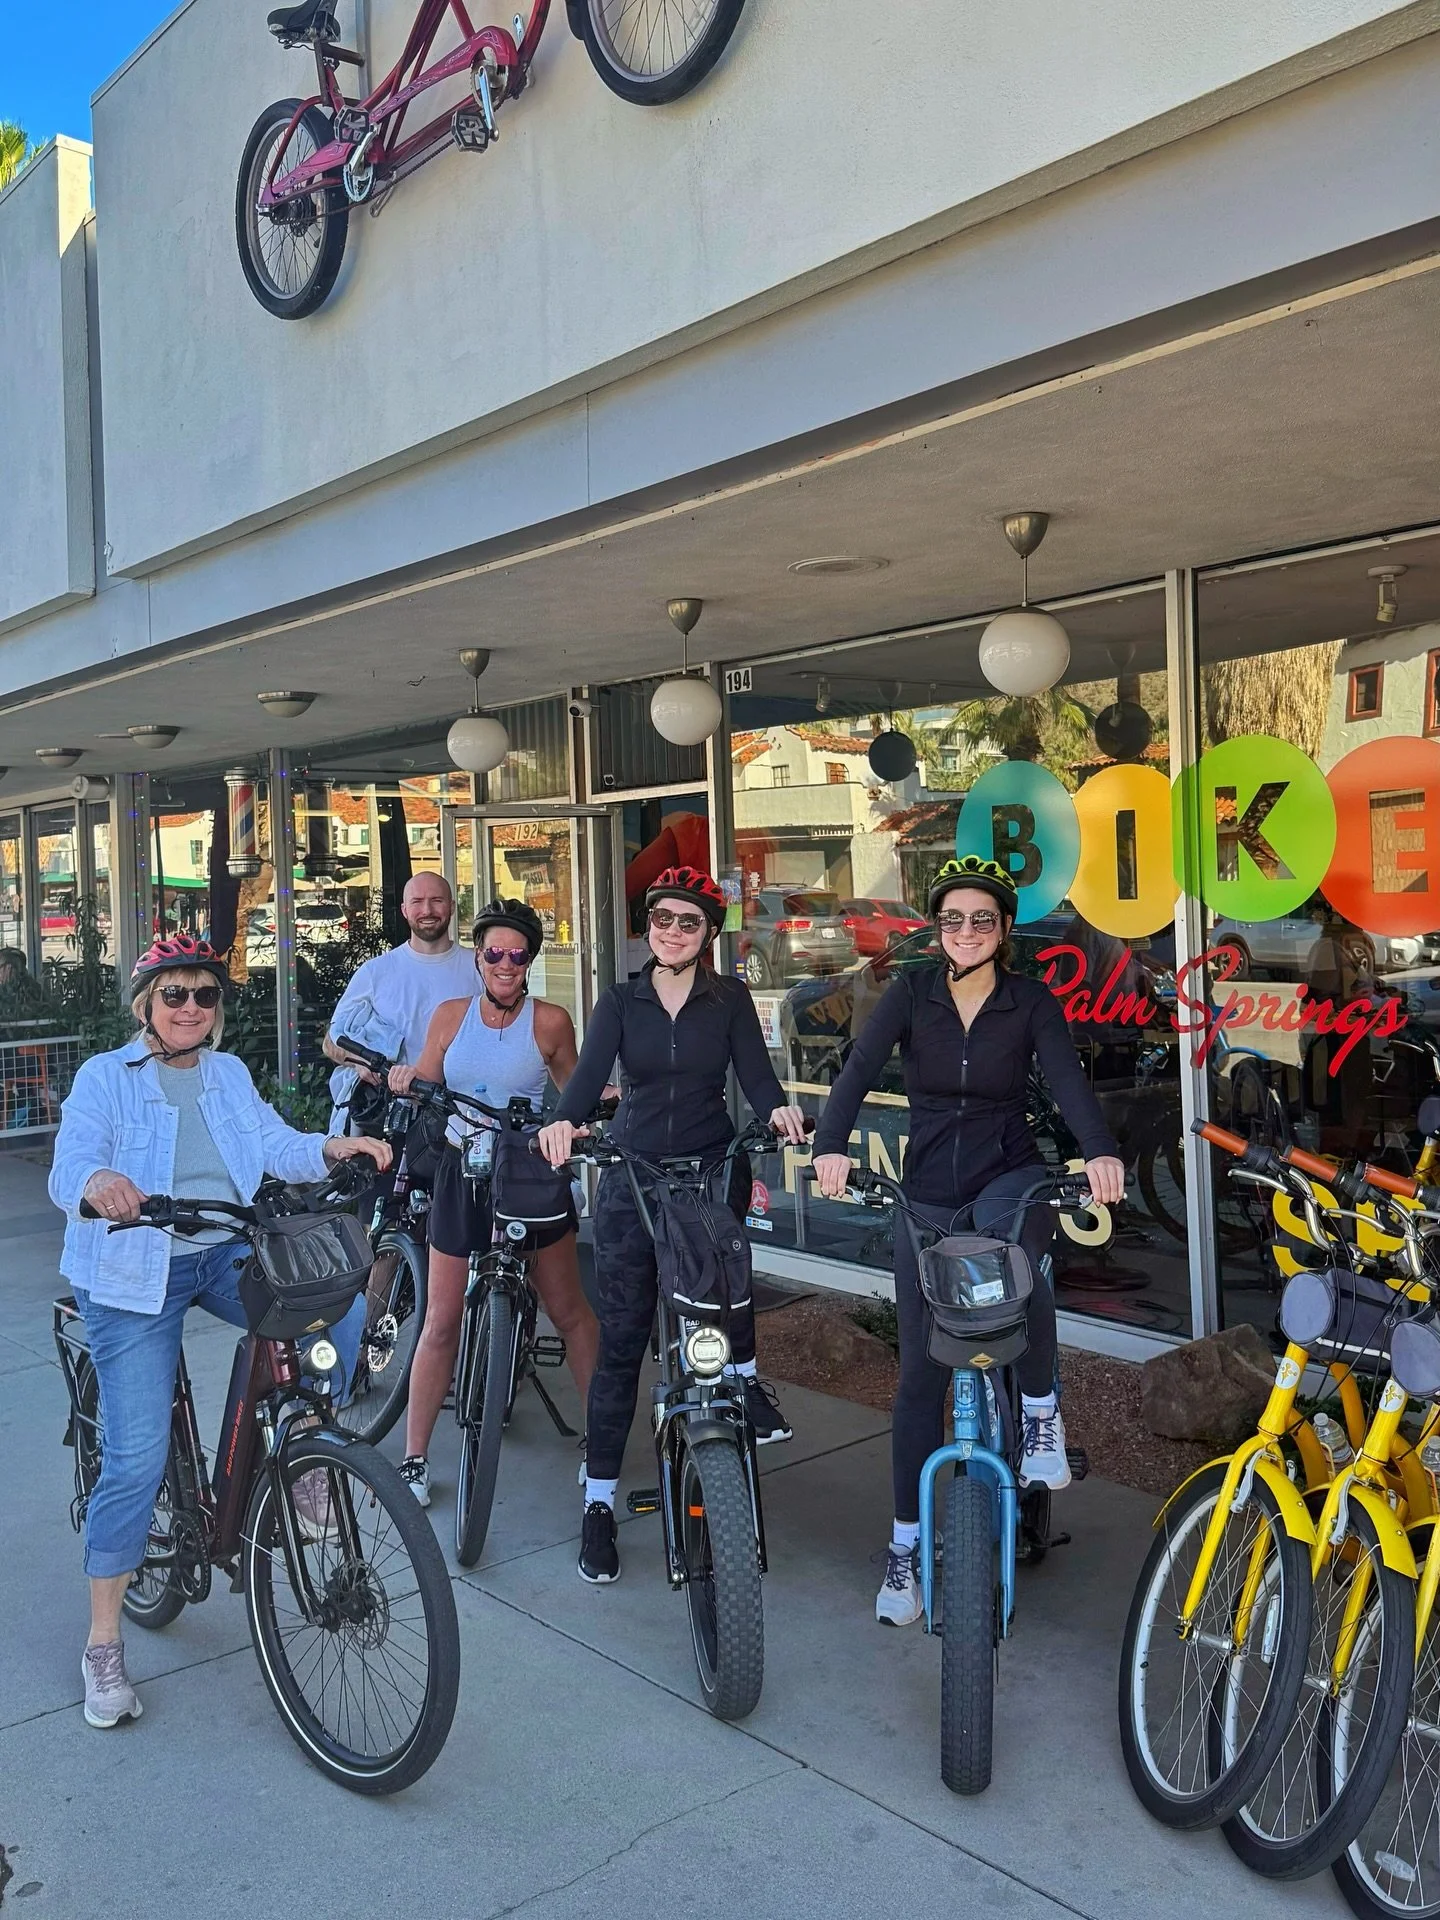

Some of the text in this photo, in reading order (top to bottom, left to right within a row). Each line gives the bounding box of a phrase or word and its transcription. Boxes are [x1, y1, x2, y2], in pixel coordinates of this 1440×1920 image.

[727, 669, 750, 692] 194
[517, 823, 538, 840] 192
[992, 781, 1429, 900] BIKE
[1035, 944, 1409, 1077] Palm Springs
[230, 1425, 238, 1457] POWER
[234, 1399, 243, 1426] BIKES
